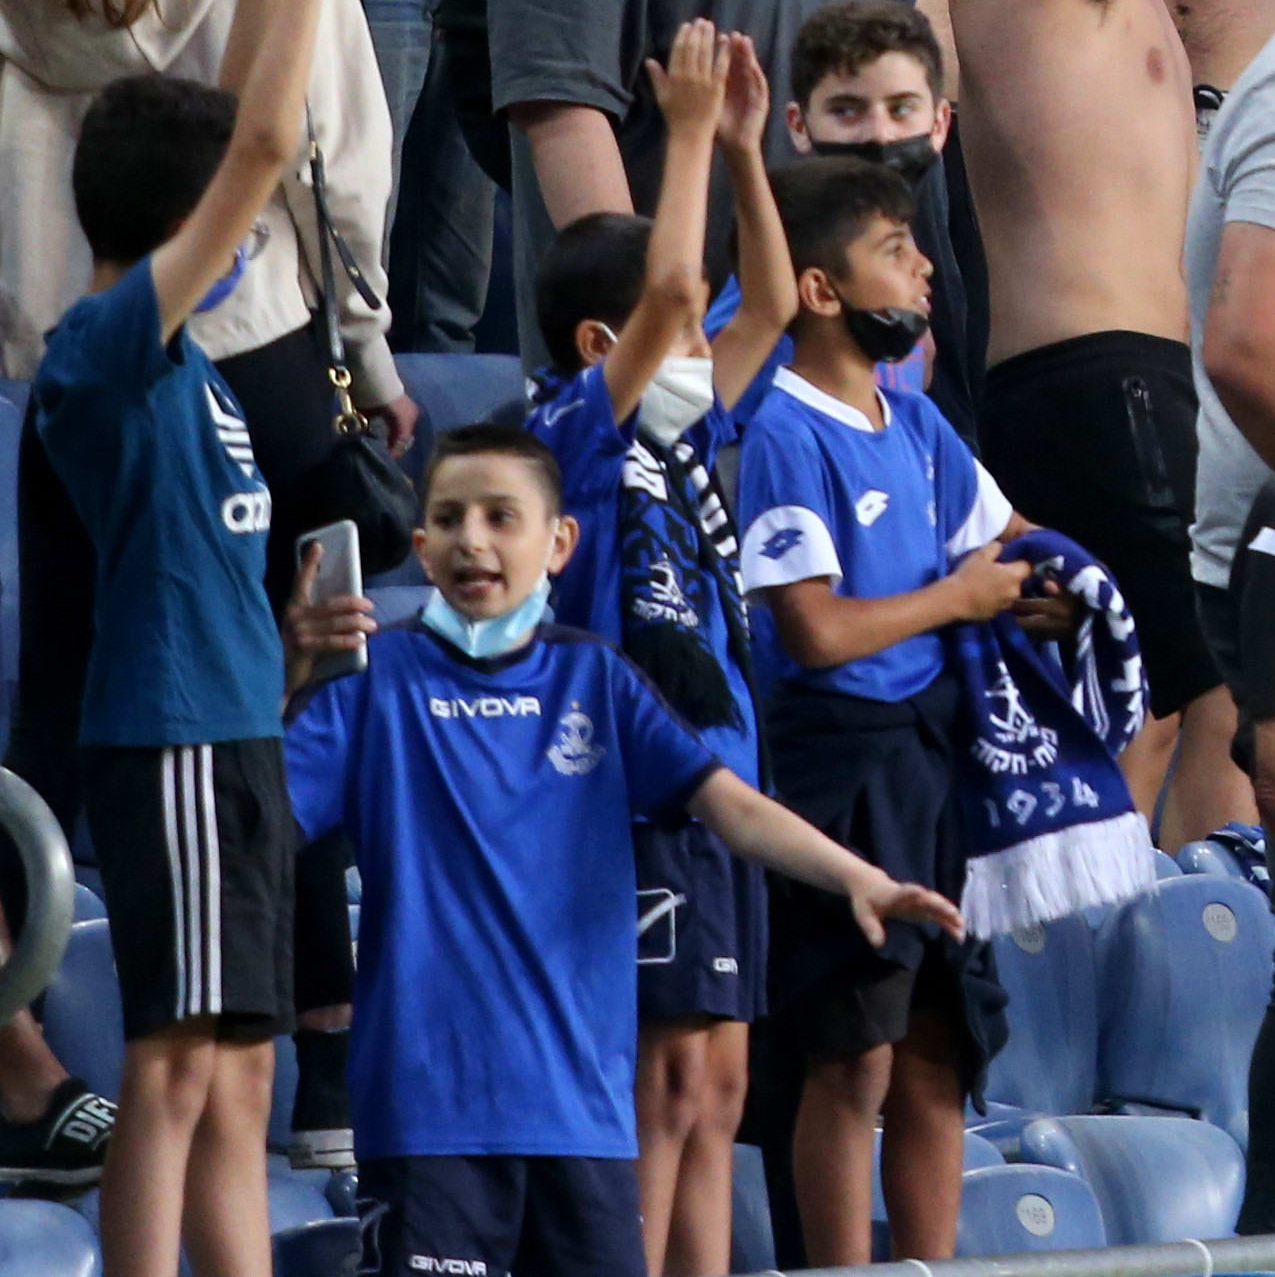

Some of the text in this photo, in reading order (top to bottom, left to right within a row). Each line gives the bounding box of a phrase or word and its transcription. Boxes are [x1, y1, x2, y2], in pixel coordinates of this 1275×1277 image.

[429, 697, 542, 719] GIVOVA
[983, 776, 1100, 828] 1934
[409, 1254, 487, 1276] GIVOVA
